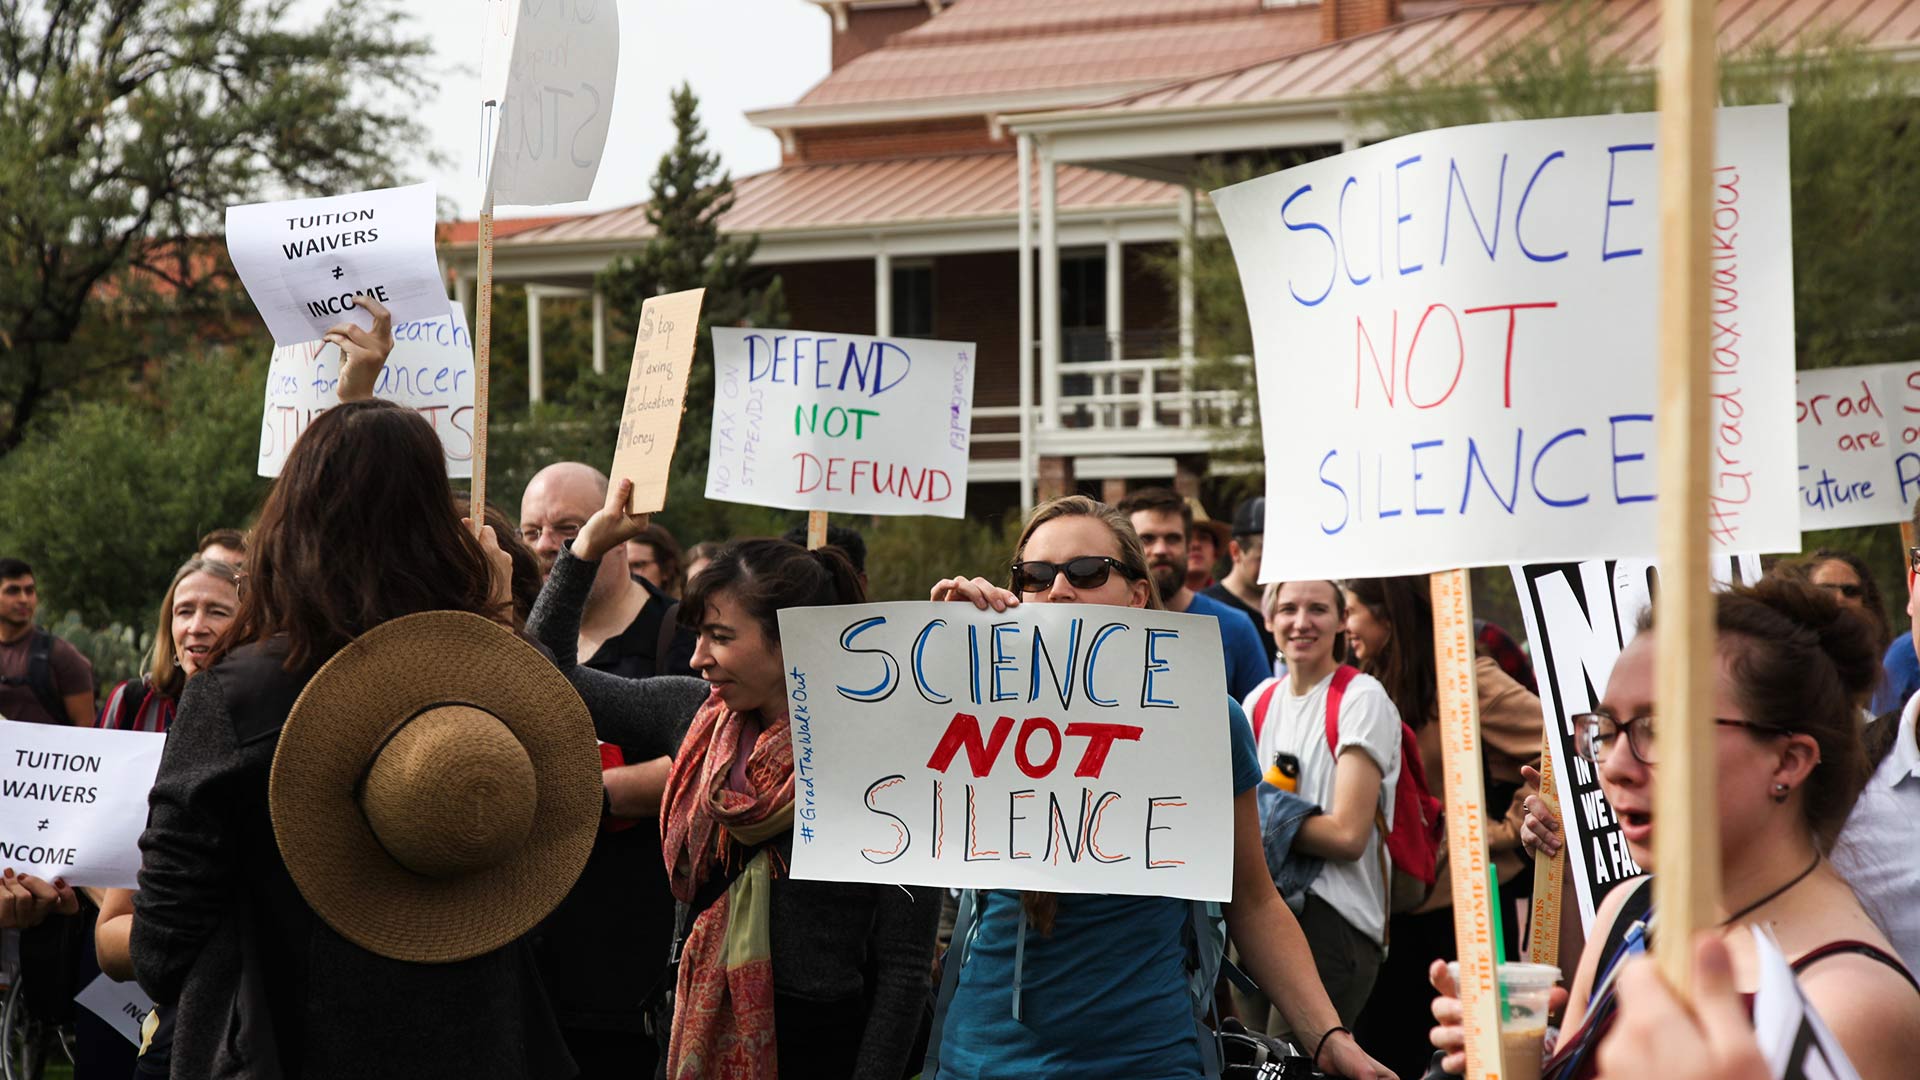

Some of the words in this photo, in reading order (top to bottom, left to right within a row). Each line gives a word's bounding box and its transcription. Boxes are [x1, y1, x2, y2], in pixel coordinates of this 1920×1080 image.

[286, 208, 375, 230] TUITION
[1281, 143, 1656, 306] SCIENCE
[282, 228, 378, 260] WAIVERS
[393, 312, 470, 348] earch
[639, 307, 674, 350] Stop
[635, 350, 673, 380] Taxing
[744, 334, 911, 398] DEFEND
[1355, 302, 1558, 409] NOT
[311, 363, 338, 400] for
[373, 363, 467, 396] ancer
[625, 386, 674, 416] Education
[722, 363, 740, 401] ON
[617, 419, 655, 455] Money
[718, 413, 736, 459] TAX
[741, 386, 764, 487] STIPENDS
[794, 403, 880, 440] NOT
[1838, 431, 1885, 452] are
[714, 464, 731, 495] NO
[792, 452, 952, 502] DEFUND
[1319, 414, 1659, 535] SILENCE
[836, 616, 1180, 710] SCIENCE
[15, 749, 101, 773] TUITION
[794, 666, 816, 844] #GradTaxWalkOut
[926, 712, 1143, 779] NOT
[3, 779, 97, 804] WAIVERS
[1573, 756, 1592, 786] IN
[861, 775, 1188, 869] SILENCE
[1580, 788, 1610, 831] WE
[1467, 802, 1484, 872] DEPOT
[1592, 836, 1611, 885] A
[1607, 829, 1643, 882] FA
[1472, 884, 1488, 944] HOME
[1478, 949, 1492, 991] THE
